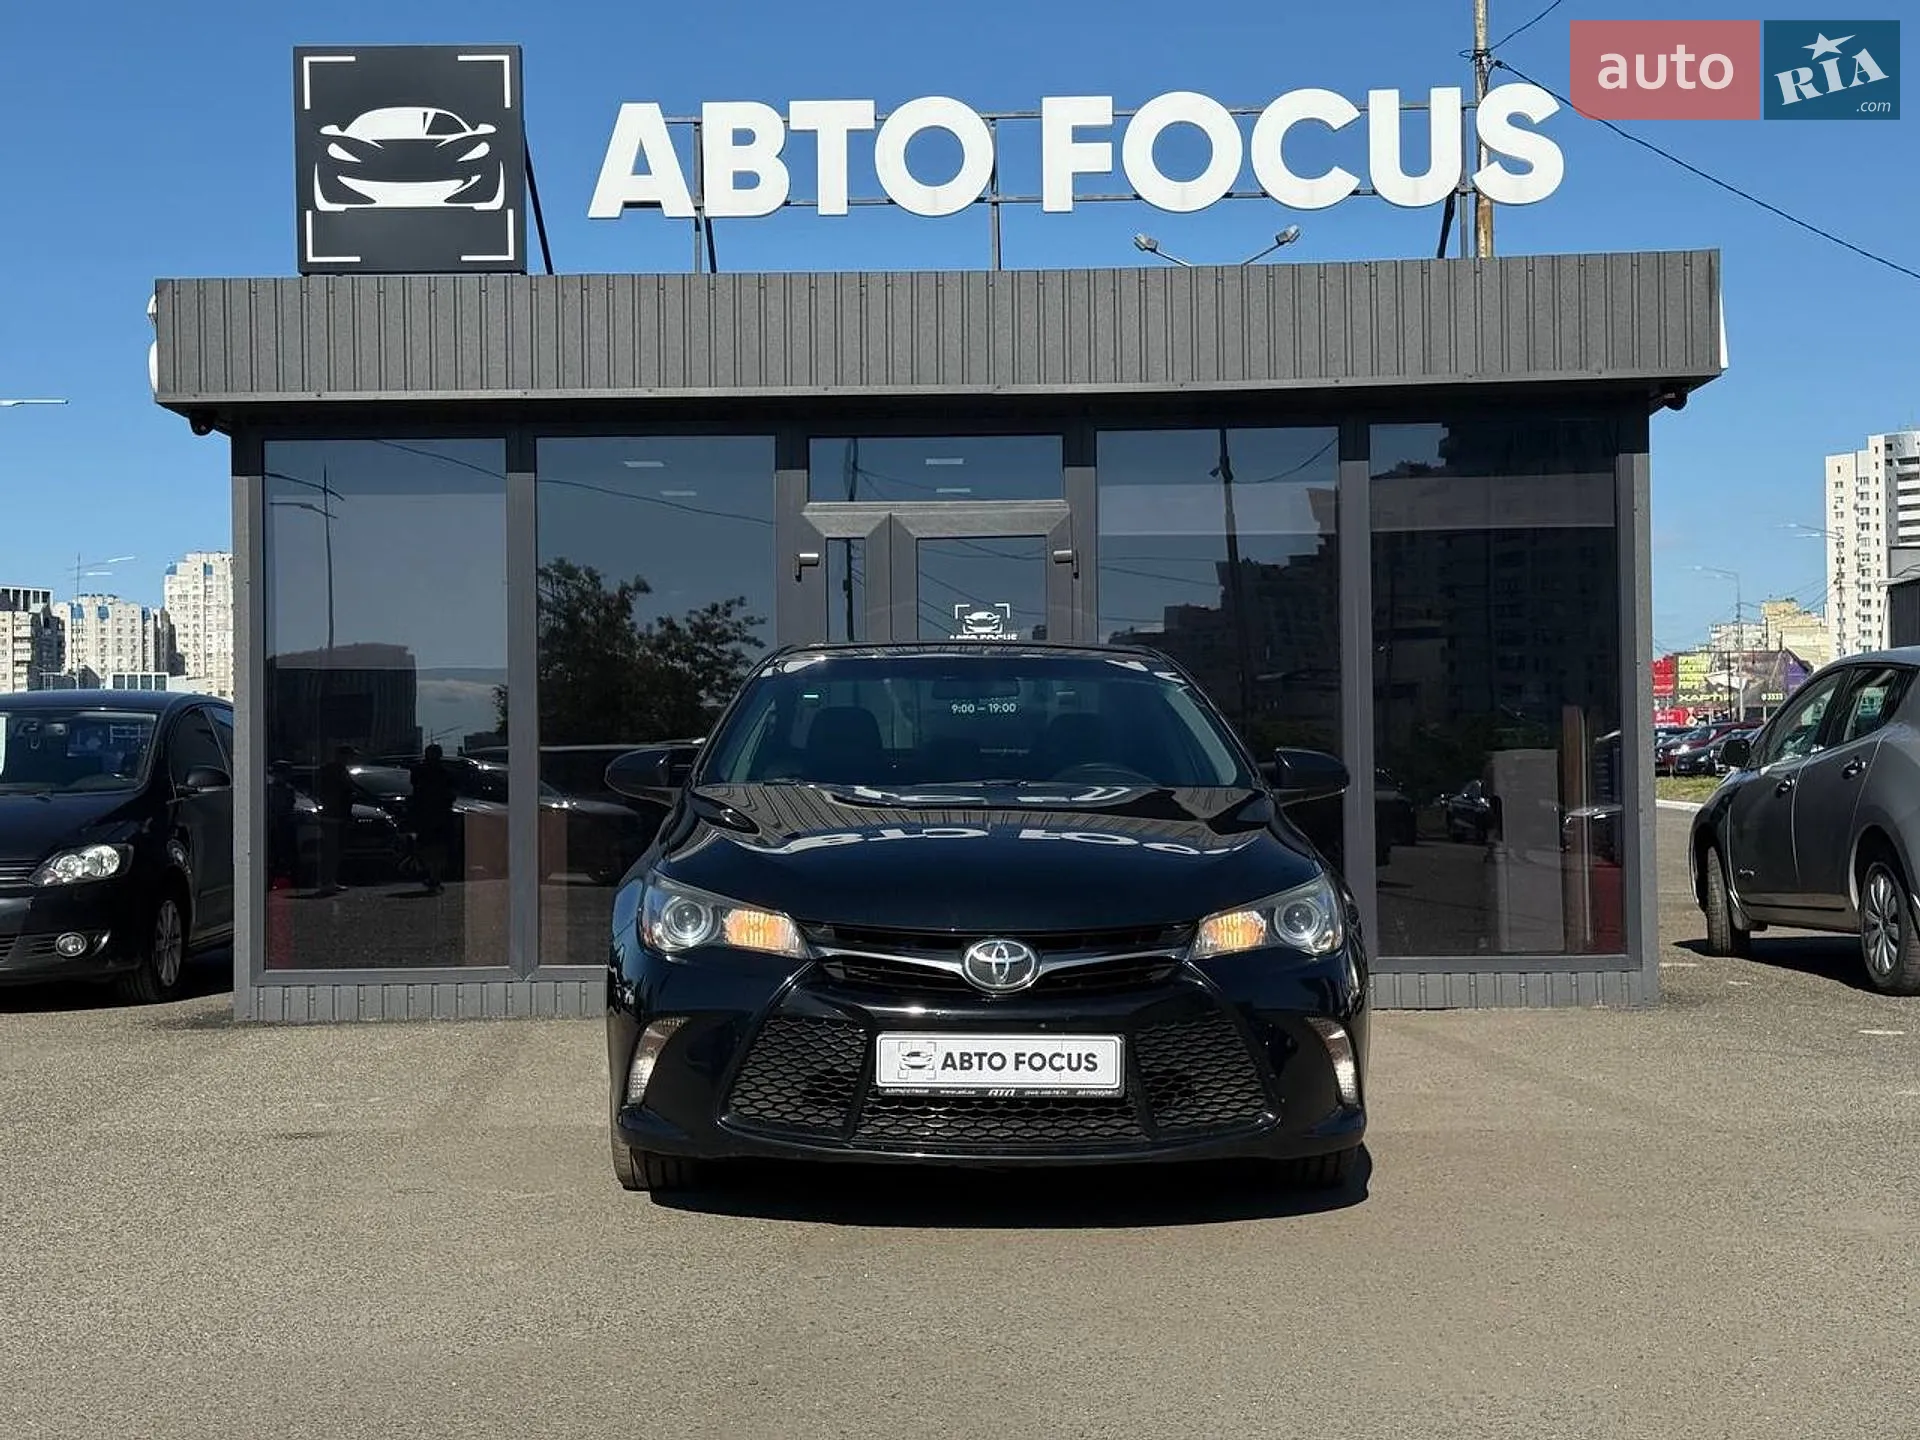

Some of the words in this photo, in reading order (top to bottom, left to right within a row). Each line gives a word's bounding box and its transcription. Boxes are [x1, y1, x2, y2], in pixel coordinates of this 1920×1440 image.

[588, 96, 995, 219] АВТО
[1041, 83, 1565, 213] FOCUS
[951, 703, 975, 714] 9:00
[988, 702, 1017, 713] 19:00
[940, 1052, 1007, 1071] АВТО
[1014, 1052, 1098, 1072] FOCUS
